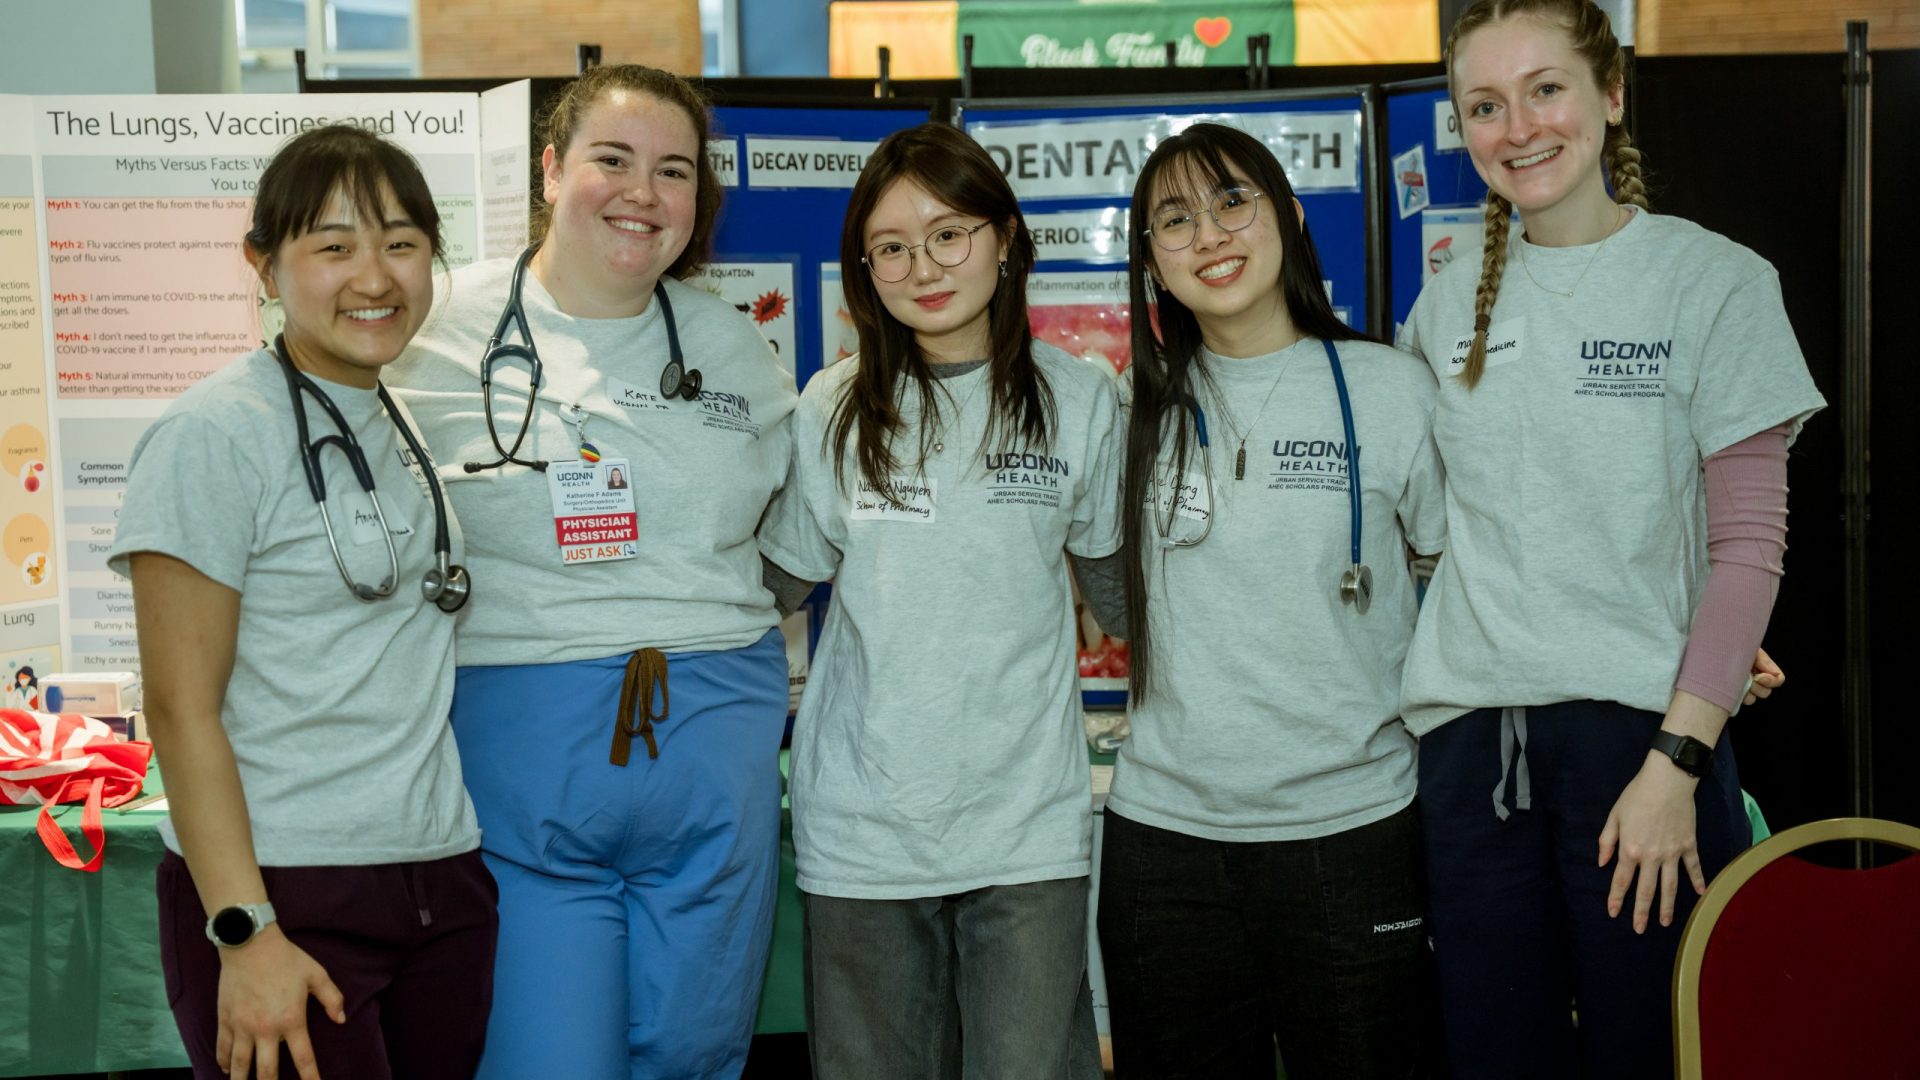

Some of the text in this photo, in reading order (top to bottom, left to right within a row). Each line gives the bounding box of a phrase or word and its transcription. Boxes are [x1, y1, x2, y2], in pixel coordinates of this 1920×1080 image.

[1105, 31, 1206, 67] Famly
[46, 111, 101, 136] The
[110, 111, 198, 143] Lungs,
[346, 110, 395, 134] and
[404, 109, 465, 135] You!
[115, 158, 157, 174] Myths
[160, 158, 207, 171] Versus
[211, 158, 250, 171] Facts:
[752, 152, 865, 172] DECAY DEVEL
[211, 178, 258, 191] You to
[12, 201, 30, 211] your
[47, 201, 72, 211] Myth
[83, 201, 101, 209] You
[122, 201, 137, 212] get
[139, 201, 155, 209] the
[156, 200, 169, 209] flu
[170, 200, 193, 209] from
[194, 201, 210, 209] the
[212, 200, 225, 209] flu
[226, 200, 247, 209] shot.
[50, 241, 75, 251] Myth
[86, 240, 101, 249] Flu
[103, 241, 142, 249] vaccines
[144, 241, 176, 252] protect
[179, 240, 212, 252] against
[214, 242, 239, 251] every
[51, 253, 122, 263] type of flu virus.
[710, 269, 755, 279] EQUATION
[1108, 280, 1122, 290] of
[53, 293, 78, 303] Myth
[80, 294, 88, 302] 3:
[112, 293, 150, 301] immune
[152, 293, 162, 301] to
[163, 293, 208, 302] COVID-19
[209, 292, 226, 301] the
[227, 292, 248, 301] after
[20, 307, 36, 316] and
[54, 306, 130, 316] get all the doses.
[56, 332, 81, 342] Myth
[82, 334, 91, 342] 4:
[98, 332, 122, 341] don't
[124, 332, 147, 341] need
[149, 333, 159, 341] to
[161, 333, 176, 343] get
[177, 332, 194, 341] the
[195, 331, 237, 341] influenza
[56, 346, 101, 354] COVID-19
[102, 345, 137, 354] vaccine
[138, 345, 146, 354] if
[169, 346, 198, 356] young
[200, 344, 217, 353] and
[1580, 339, 1672, 361] UCONN
[1588, 364, 1660, 376] HEALTH
[58, 371, 83, 382] Myth
[95, 371, 129, 380] Natural
[132, 371, 174, 382] immunity
[175, 372, 186, 380] to
[10, 386, 41, 396] asthma
[59, 384, 190, 397] better than getting the vacci
[624, 388, 657, 402] KATE
[613, 399, 649, 409] UCONN
[698, 390, 751, 416] CONN
[8, 446, 39, 456] Fragrance
[80, 462, 124, 471] Common
[985, 453, 1069, 476] UCONN
[1280, 461, 1348, 474] HEALTH
[77, 475, 128, 485] Symptoms
[557, 472, 594, 481] UCONN
[996, 473, 1058, 488] HEALTH
[894, 480, 931, 501] Nguyen
[879, 501, 888, 513] of
[890, 502, 930, 517] Pharmacy
[562, 516, 631, 530] PHYSICIAN
[91, 526, 112, 535] Sore
[563, 528, 632, 543] ASSISTANT
[565, 545, 622, 561] JUST ASK
[106, 603, 135, 613] Vomit
[3, 612, 35, 627] Lung
[94, 621, 122, 632] Runny
[108, 638, 137, 647] Sneez
[84, 655, 106, 666] Itchy
[120, 656, 141, 664] wate
